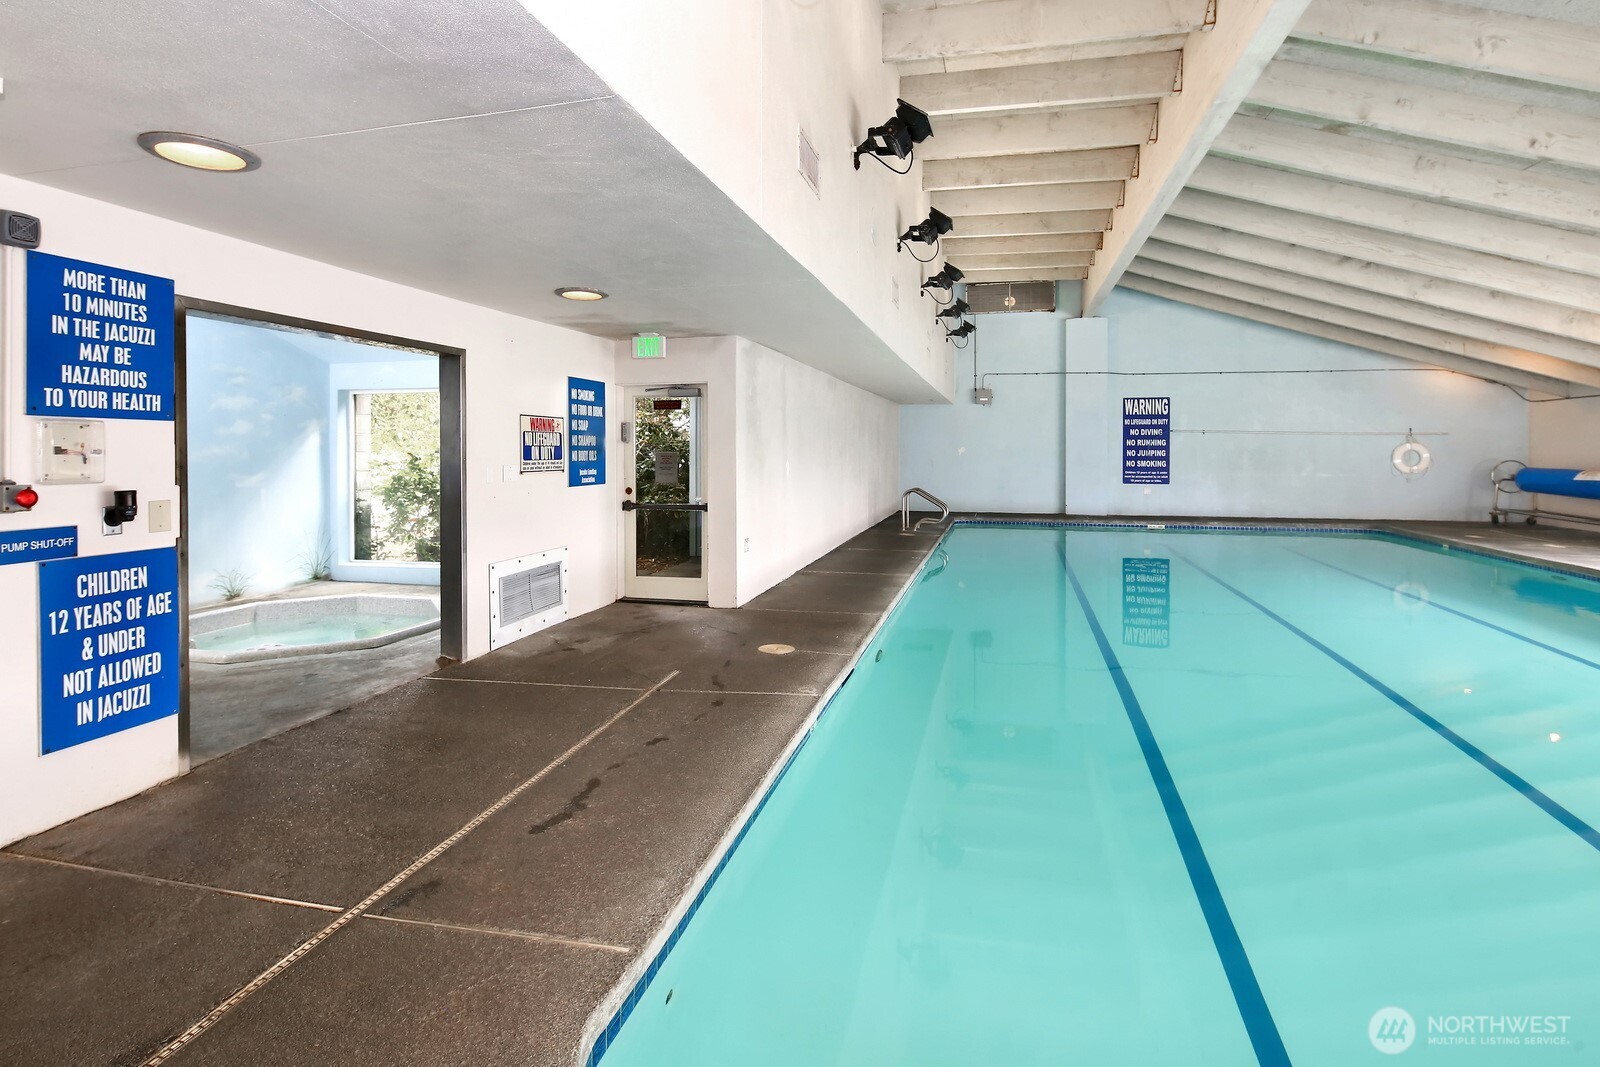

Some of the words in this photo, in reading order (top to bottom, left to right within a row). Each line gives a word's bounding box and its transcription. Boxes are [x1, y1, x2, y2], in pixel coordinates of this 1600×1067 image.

[63, 268, 105, 294] MORE
[110, 277, 146, 300] THAN
[63, 292, 81, 312] 10
[86, 296, 147, 323] MINUTES
[52, 315, 68, 335] IN
[72, 318, 100, 339] THE
[104, 322, 155, 346] JACUZZI
[79, 343, 109, 363] MAY
[114, 348, 132, 366] BE
[637, 336, 660, 357] EXIT
[62, 364, 147, 389] HAZARDOUS
[44, 387, 63, 407] TO
[68, 389, 108, 410] YOUR
[112, 392, 161, 412] HEALTH
[571, 388, 578, 400] NO
[578, 389, 595, 402] SMOKING
[571, 404, 578, 416] NO
[578, 404, 587, 417] FOOD
[1124, 398, 1169, 415] WARNING
[529, 417, 555, 433] WARNING
[571, 419, 578, 431] NO
[578, 419, 589, 431] SOAP
[524, 431, 533, 447] NO
[533, 431, 561, 448] LIFEGUARD
[571, 435, 578, 446] NO
[578, 435, 597, 447] SHAMPOO
[531, 446, 540, 460] ON
[540, 446, 555, 461] DUTY
[571, 450, 578, 462] NO
[578, 450, 589, 461] BODY
[1, 542, 28, 552] PUMP
[30, 537, 75, 550] SHUT-OFF
[76, 566, 148, 598] CHILDREN
[49, 609, 69, 636] 12
[74, 600, 122, 631] YEARS
[126, 596, 143, 621] OF
[147, 591, 172, 617] AGE
[81, 636, 93, 661] &
[98, 626, 145, 657] UNDER
[62, 668, 94, 698] NOT
[98, 652, 162, 689] ALLOWED
[76, 698, 93, 726] IN
[97, 683, 150, 722] JACUZZI
